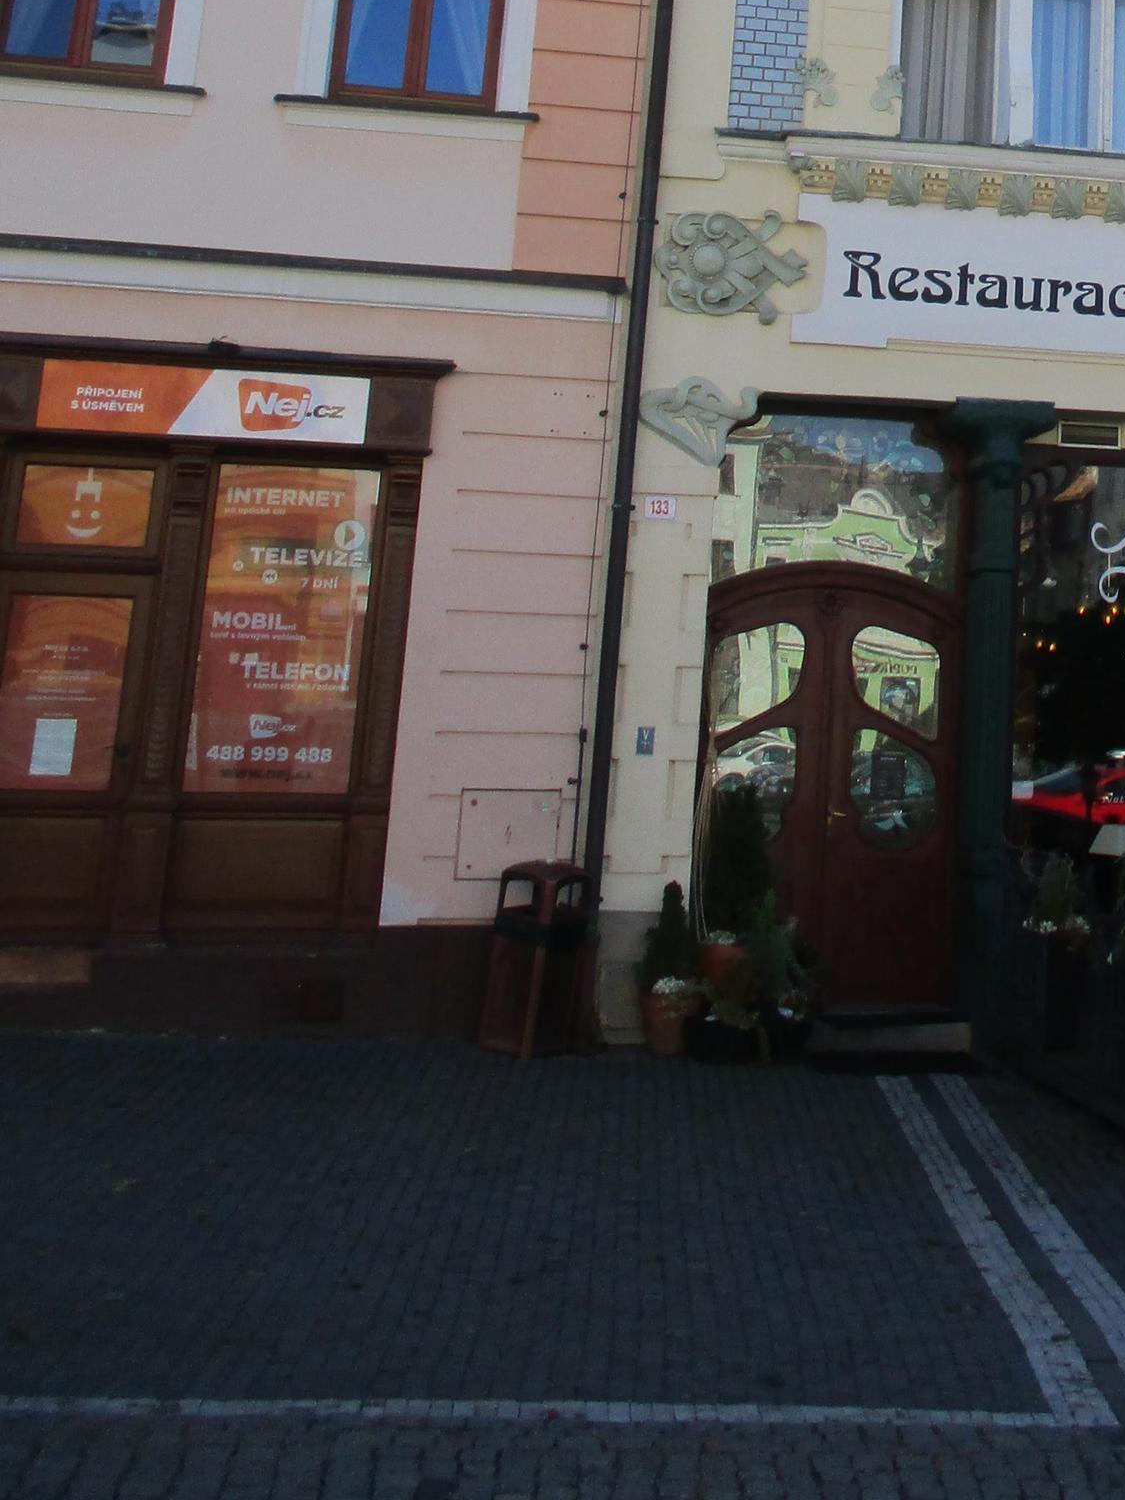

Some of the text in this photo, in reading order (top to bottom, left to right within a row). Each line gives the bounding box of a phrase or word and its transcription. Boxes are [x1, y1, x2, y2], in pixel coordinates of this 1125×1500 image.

[76, 385, 143, 399] PŘIPOJENÍ
[70, 398, 145, 413] S ÚSMĚVEM
[244, 391, 344, 422] Nej.cz
[226, 486, 345, 508] INTERNET
[650, 499, 670, 515] 133
[250, 546, 363, 568] TELEVIZE
[212, 611, 284, 630] MOBIL
[243, 661, 350, 682] TELEFON
[206, 746, 333, 763] 488 999 488
